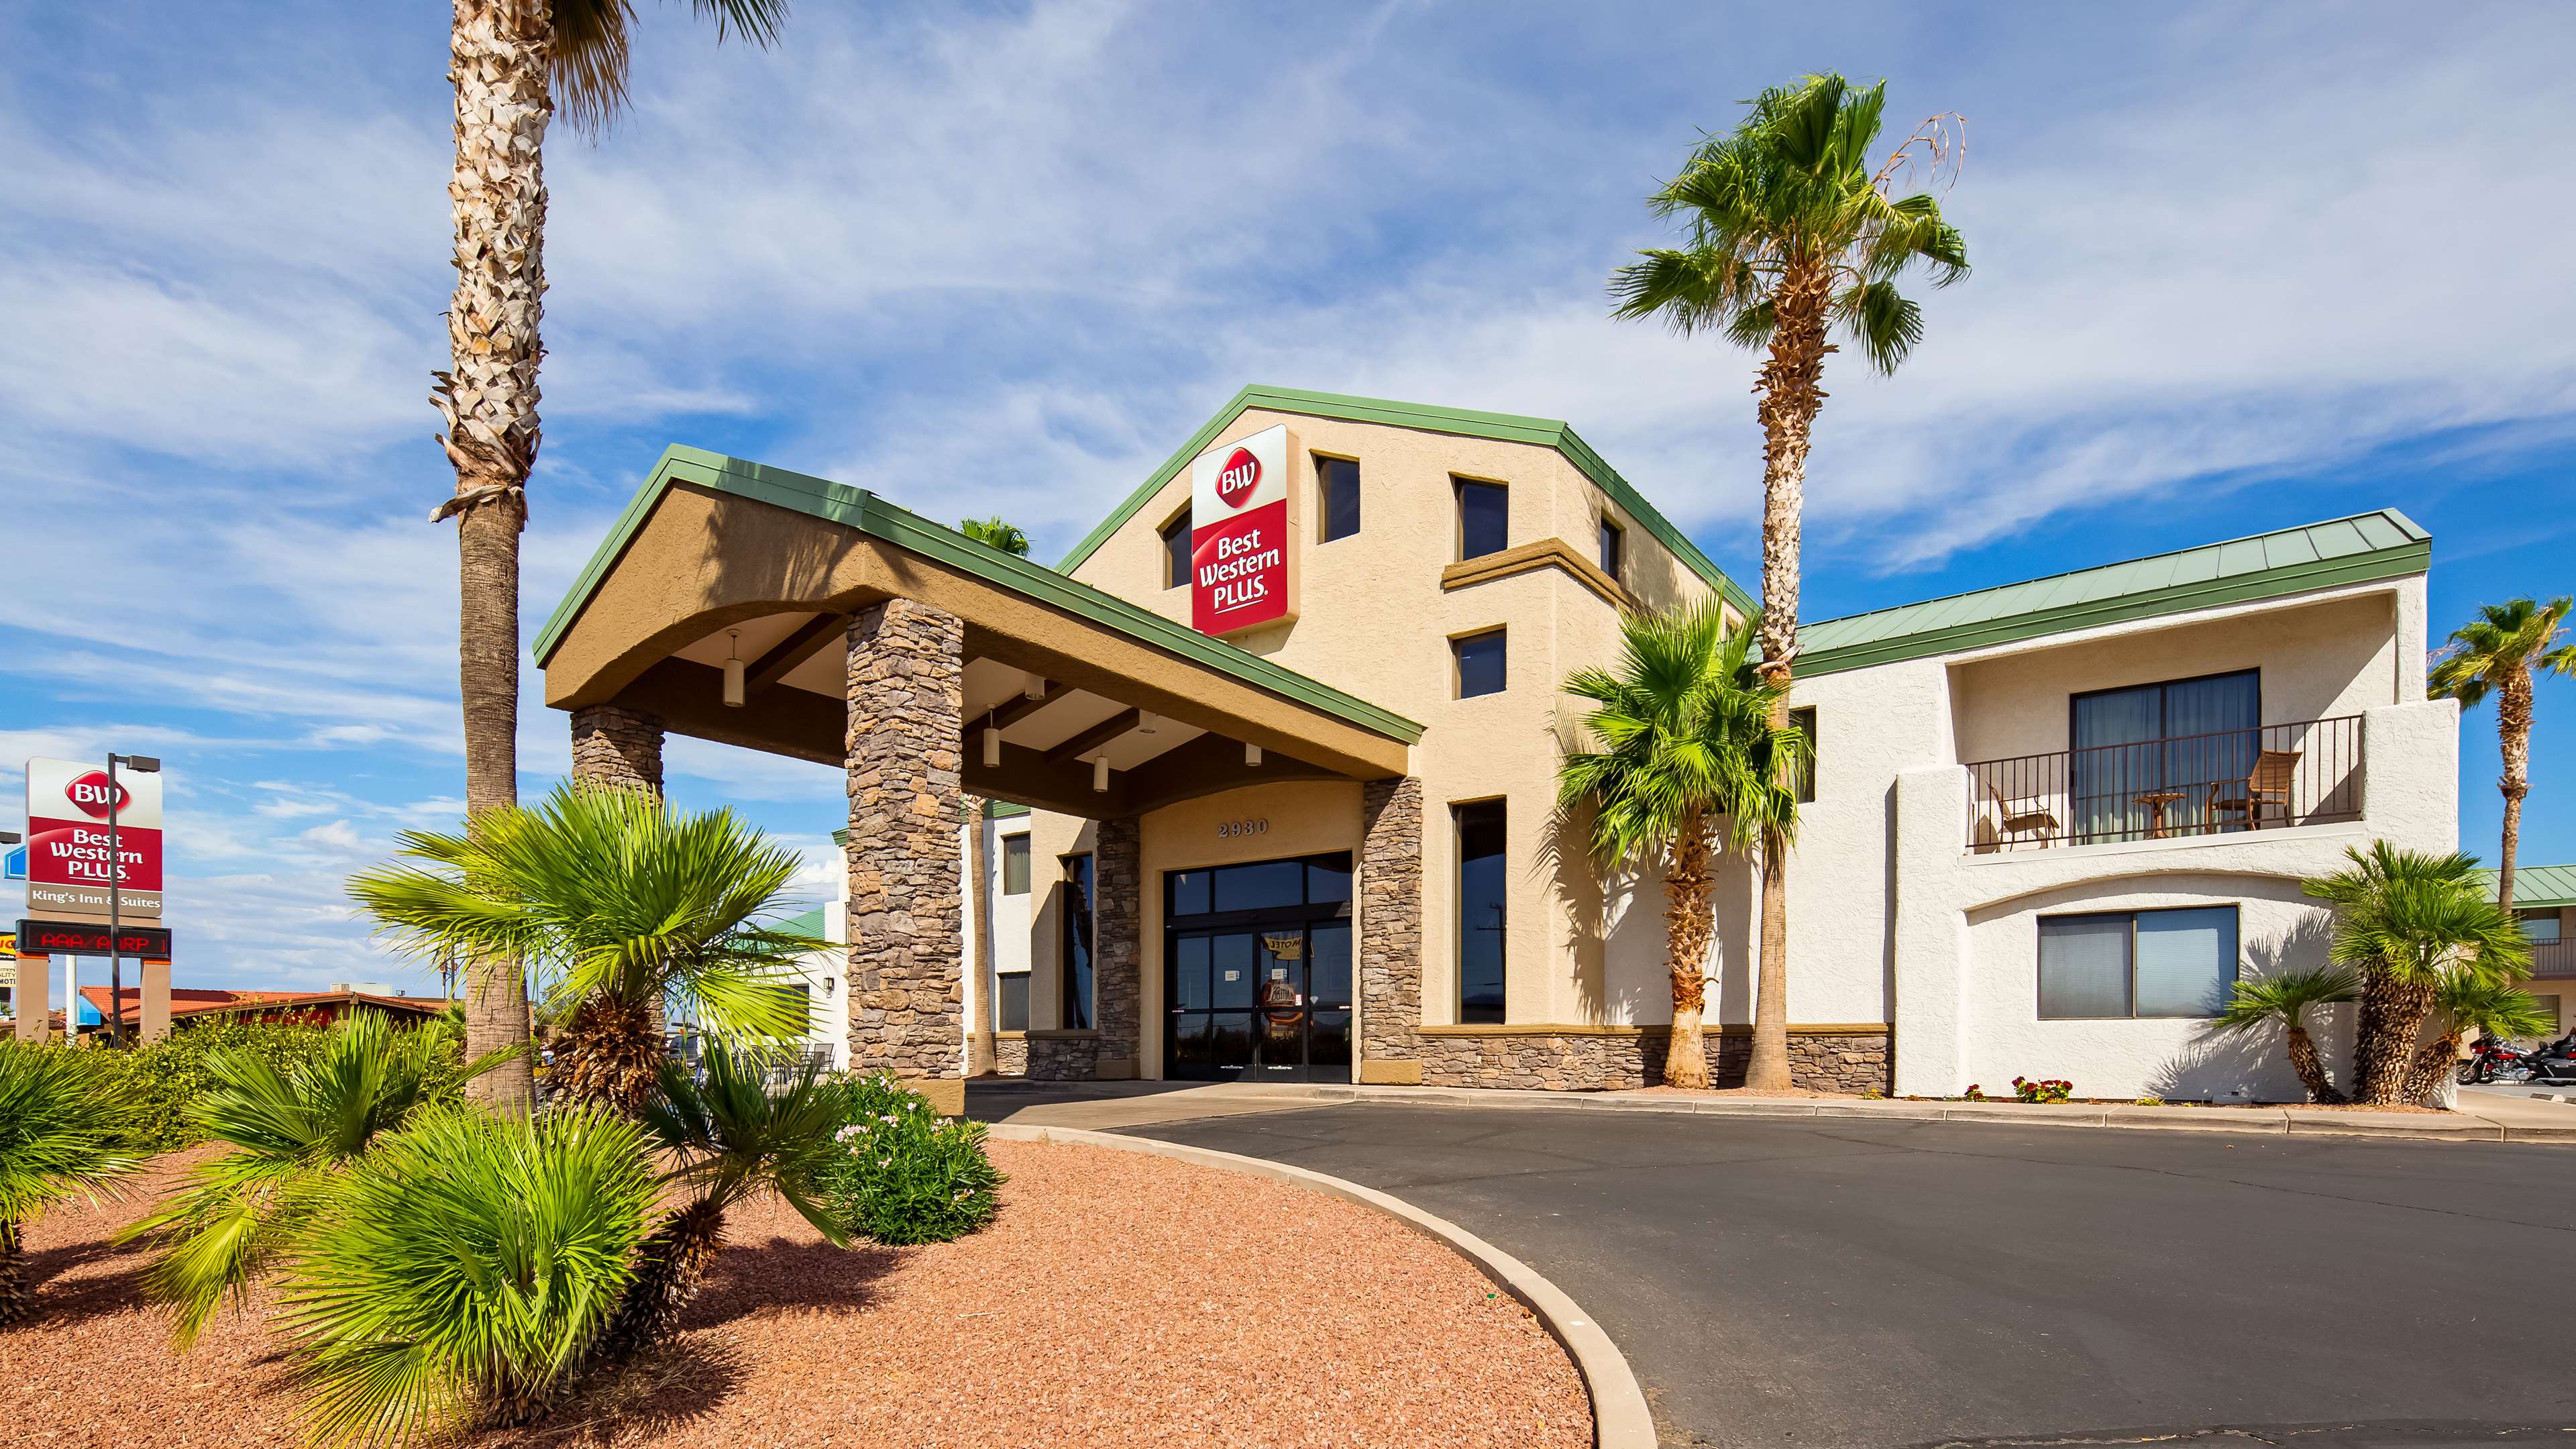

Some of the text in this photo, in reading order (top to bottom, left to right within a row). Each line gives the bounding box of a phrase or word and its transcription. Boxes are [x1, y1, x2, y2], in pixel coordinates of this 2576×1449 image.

[1222, 462, 1255, 495] BW
[1218, 529, 1261, 559] Best
[1199, 548, 1280, 588] Western
[75, 784, 121, 805] BW
[73, 829, 123, 847] Best
[1218, 819, 1268, 838] 2930
[33, 890, 76, 904] King's
[79, 894, 103, 904] Inn
[120, 897, 161, 908] Suites
